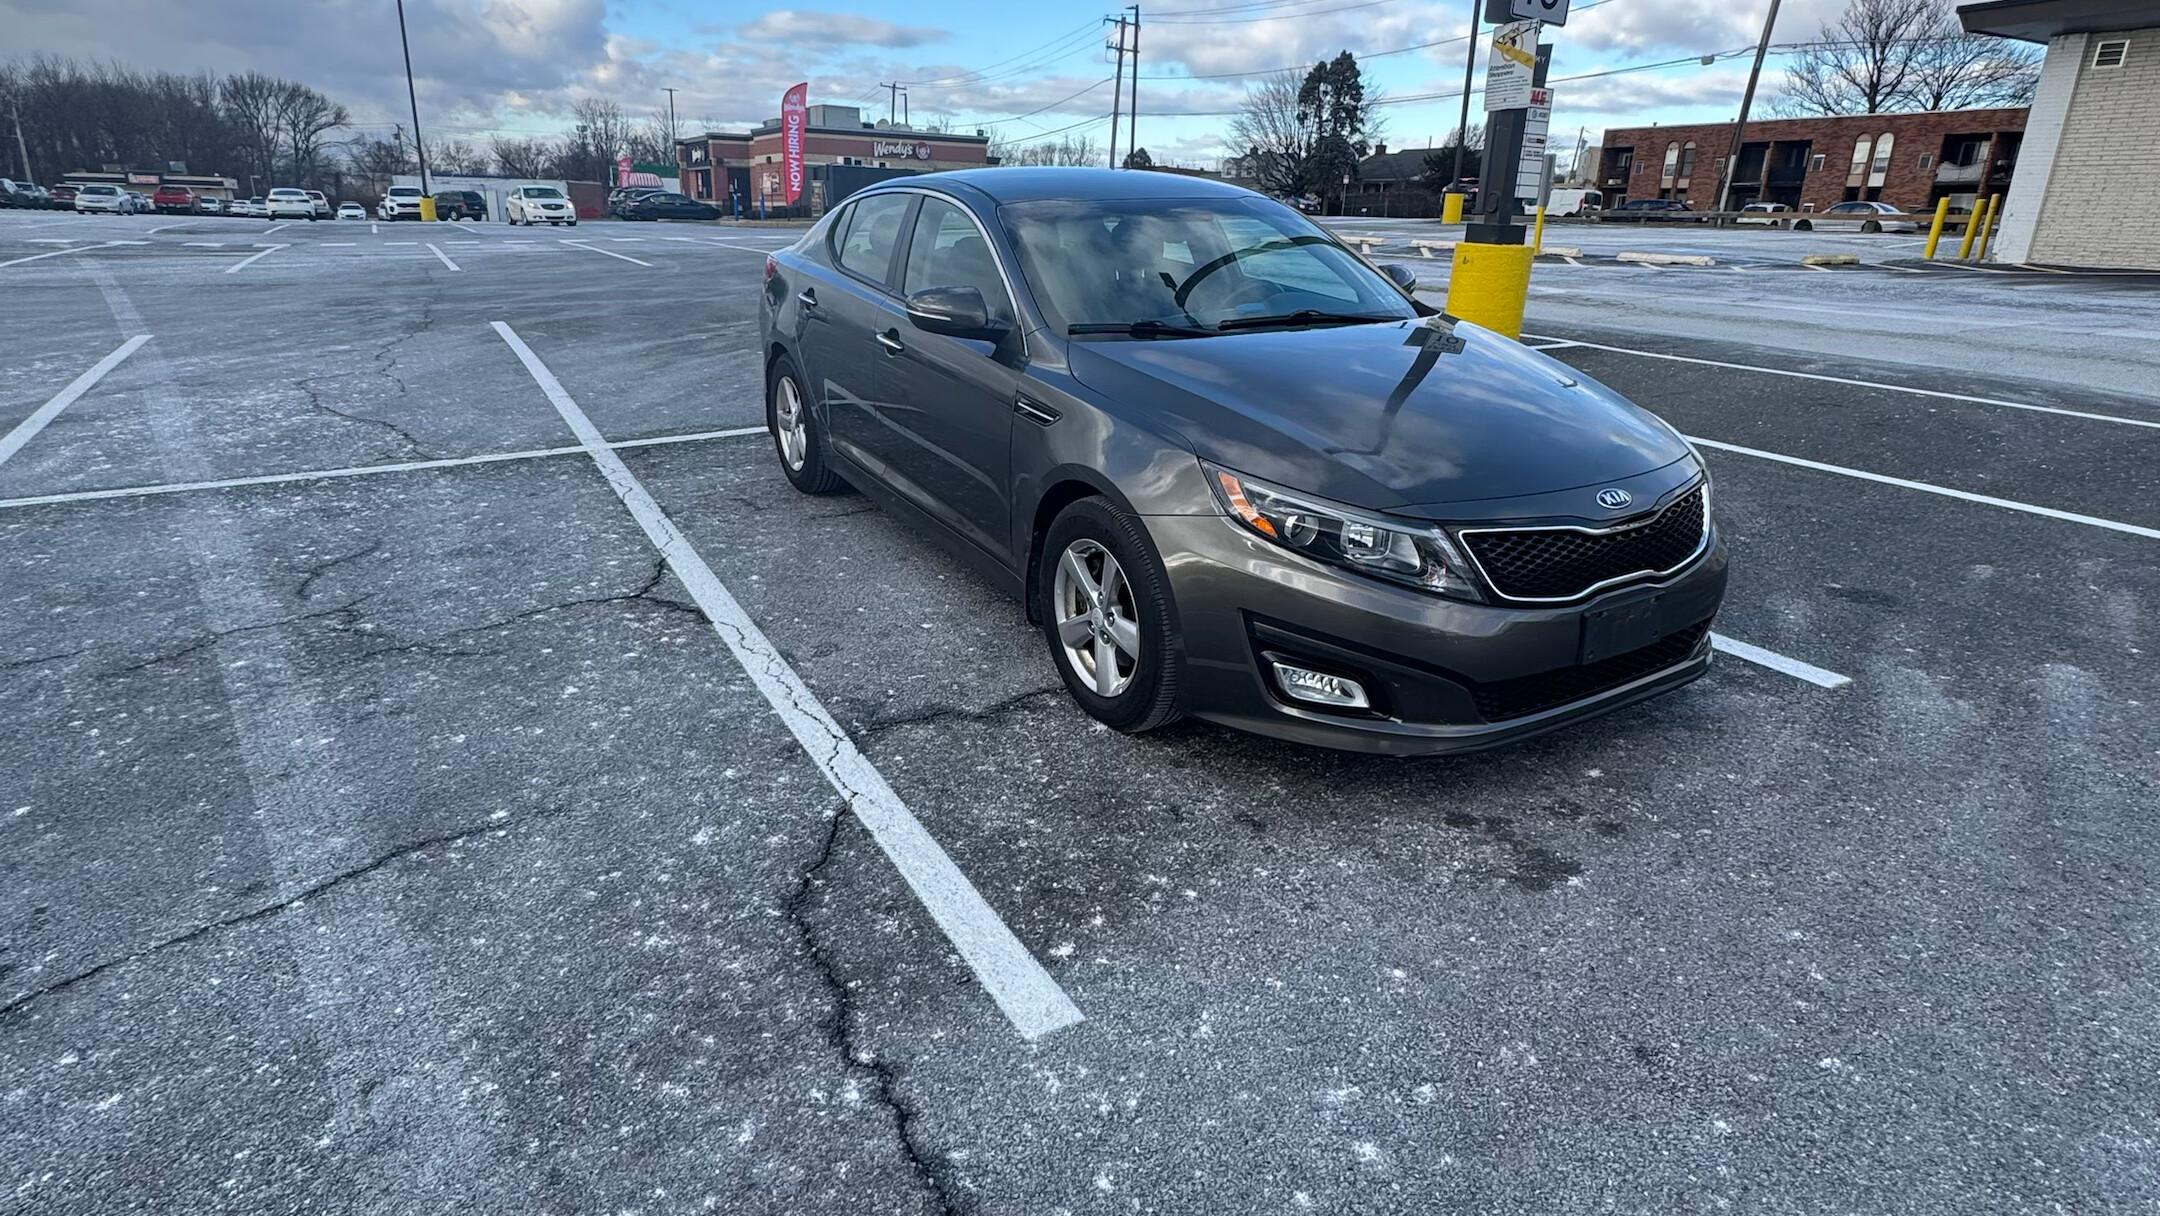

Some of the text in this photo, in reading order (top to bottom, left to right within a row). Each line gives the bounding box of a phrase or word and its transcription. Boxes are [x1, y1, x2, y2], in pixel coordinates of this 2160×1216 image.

[788, 115, 801, 158] HIRING
[873, 140, 913, 159] Wendy's
[790, 158, 801, 192] NOW
[1600, 490, 1630, 504] KIA
